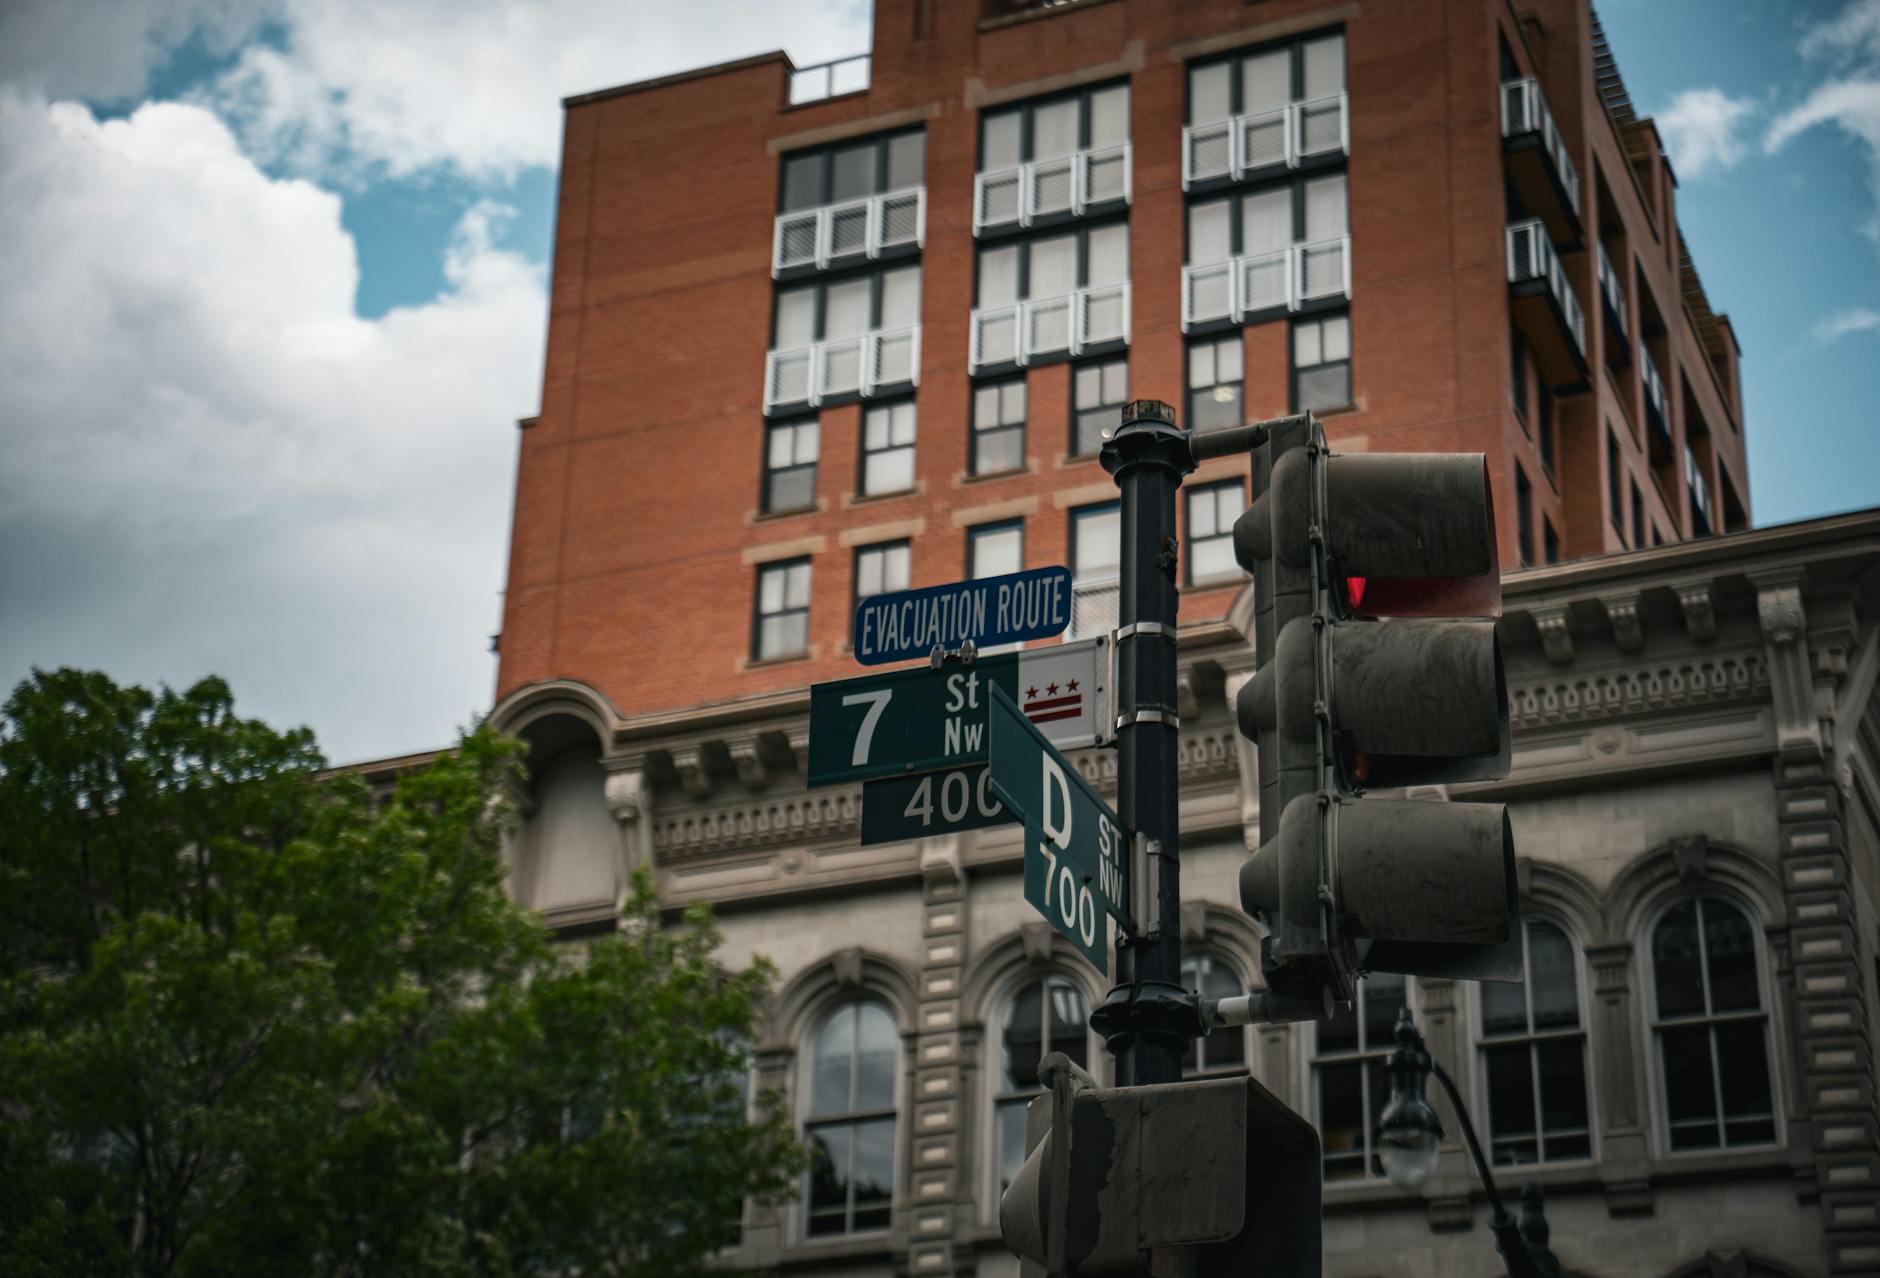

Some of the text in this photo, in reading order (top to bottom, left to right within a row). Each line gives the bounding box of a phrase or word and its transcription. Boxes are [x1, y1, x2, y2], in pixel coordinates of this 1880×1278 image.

[862, 575, 1065, 656] EVACUATION ROUTE
[842, 689, 893, 766] 7
[946, 672, 980, 713] St
[1042, 750, 1072, 850] D
[1099, 813, 1122, 867] ST
[1039, 842, 1095, 947] 700
[1099, 853, 1123, 909] NW
